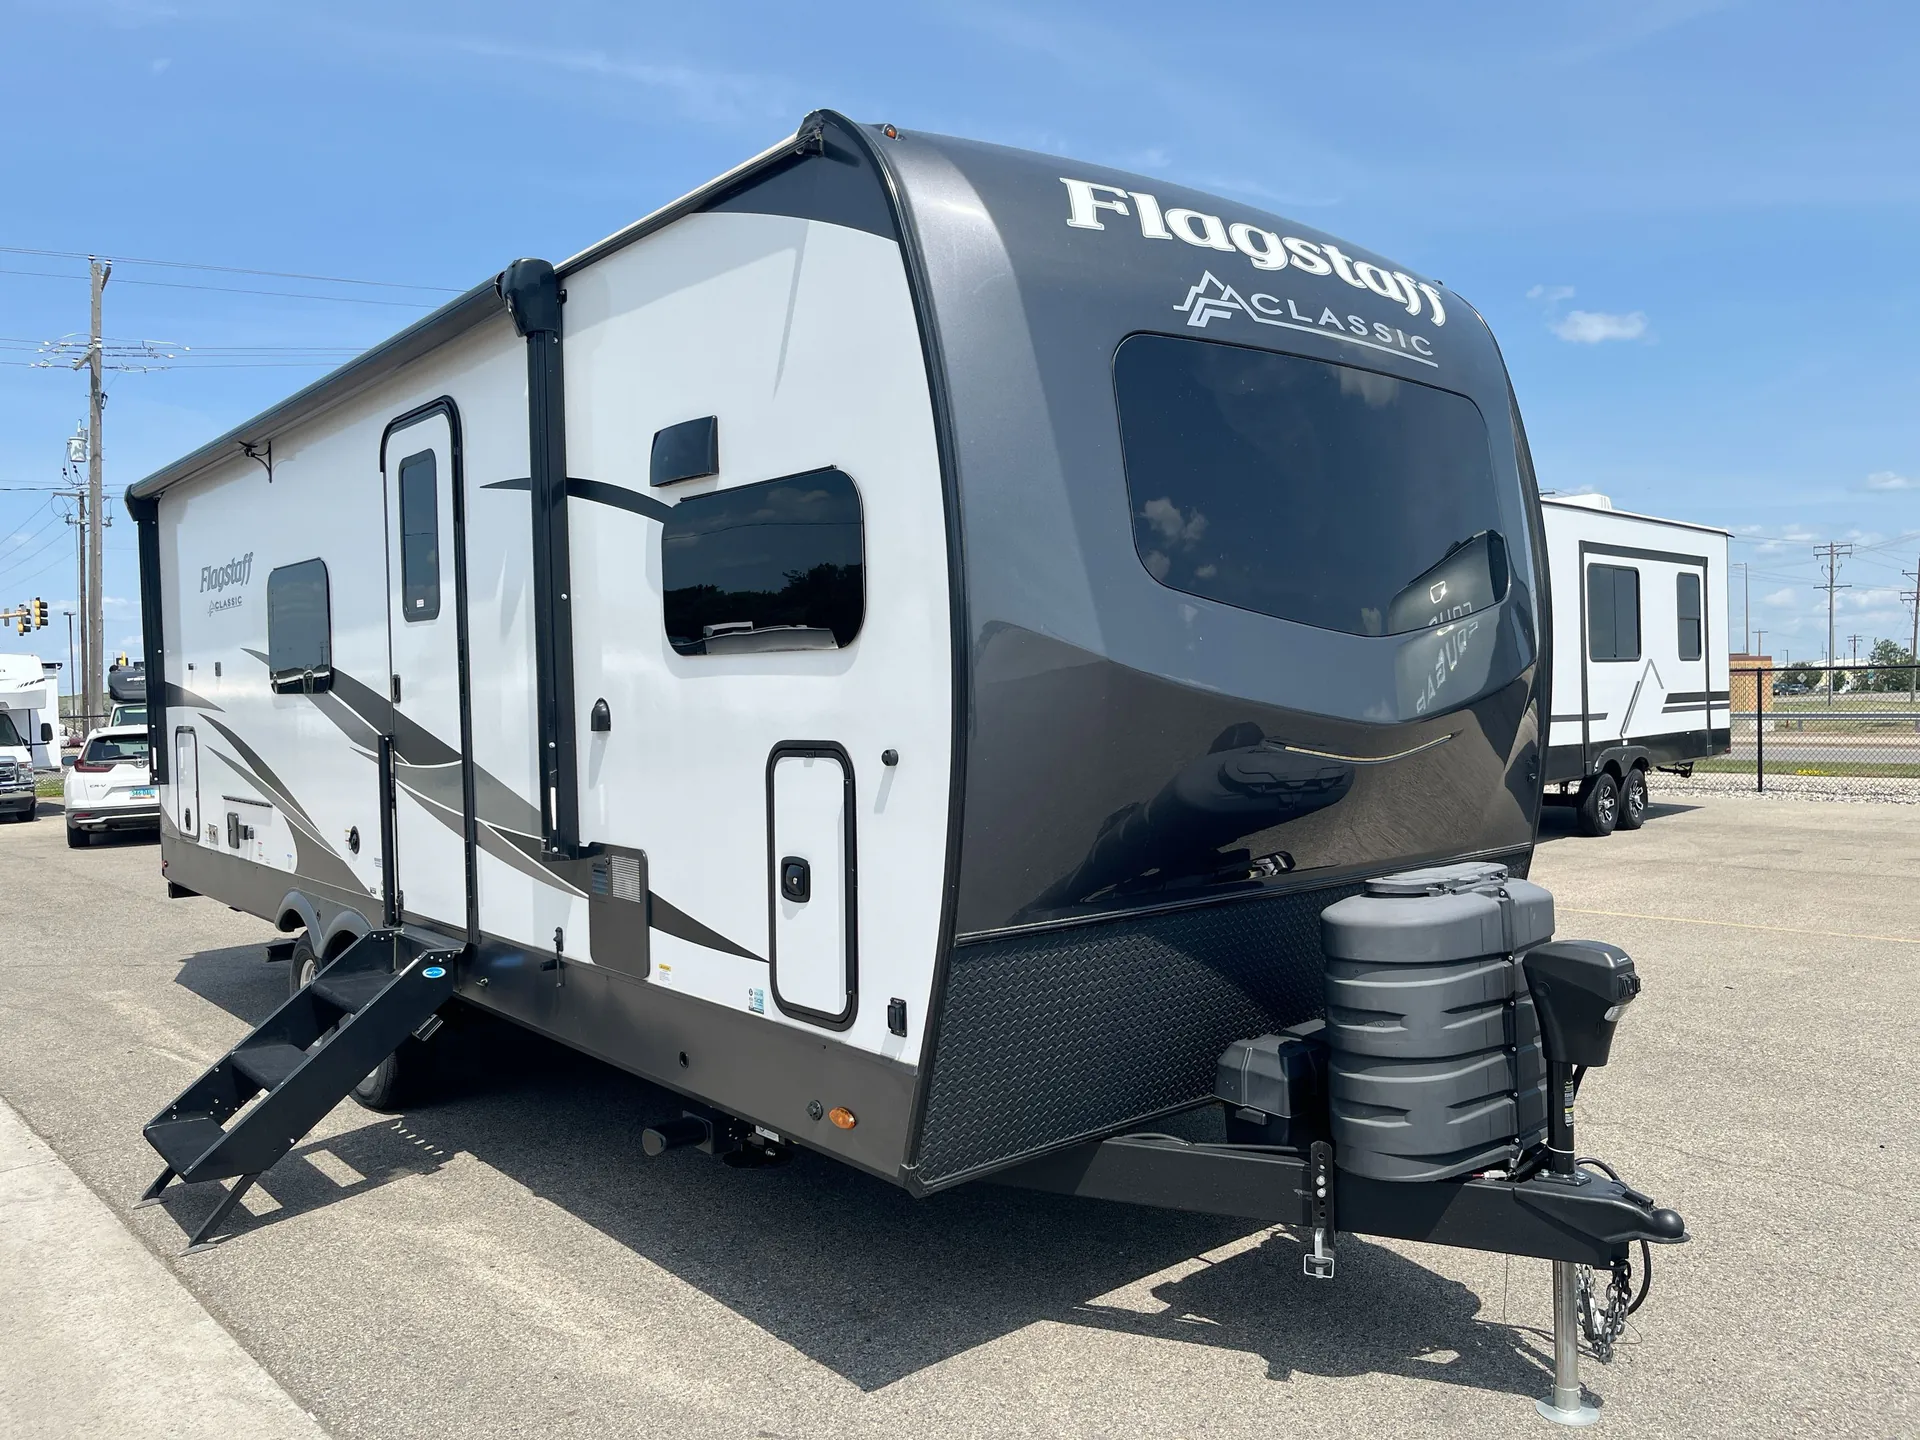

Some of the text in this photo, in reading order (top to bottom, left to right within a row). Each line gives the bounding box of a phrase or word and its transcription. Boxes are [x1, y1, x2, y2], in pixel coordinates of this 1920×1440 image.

[1059, 177, 1446, 327] Flagstaff
[1250, 293, 1434, 356] CLASSIC
[200, 552, 253, 593] Flagstaff
[215, 596, 243, 609] CLASSIC
